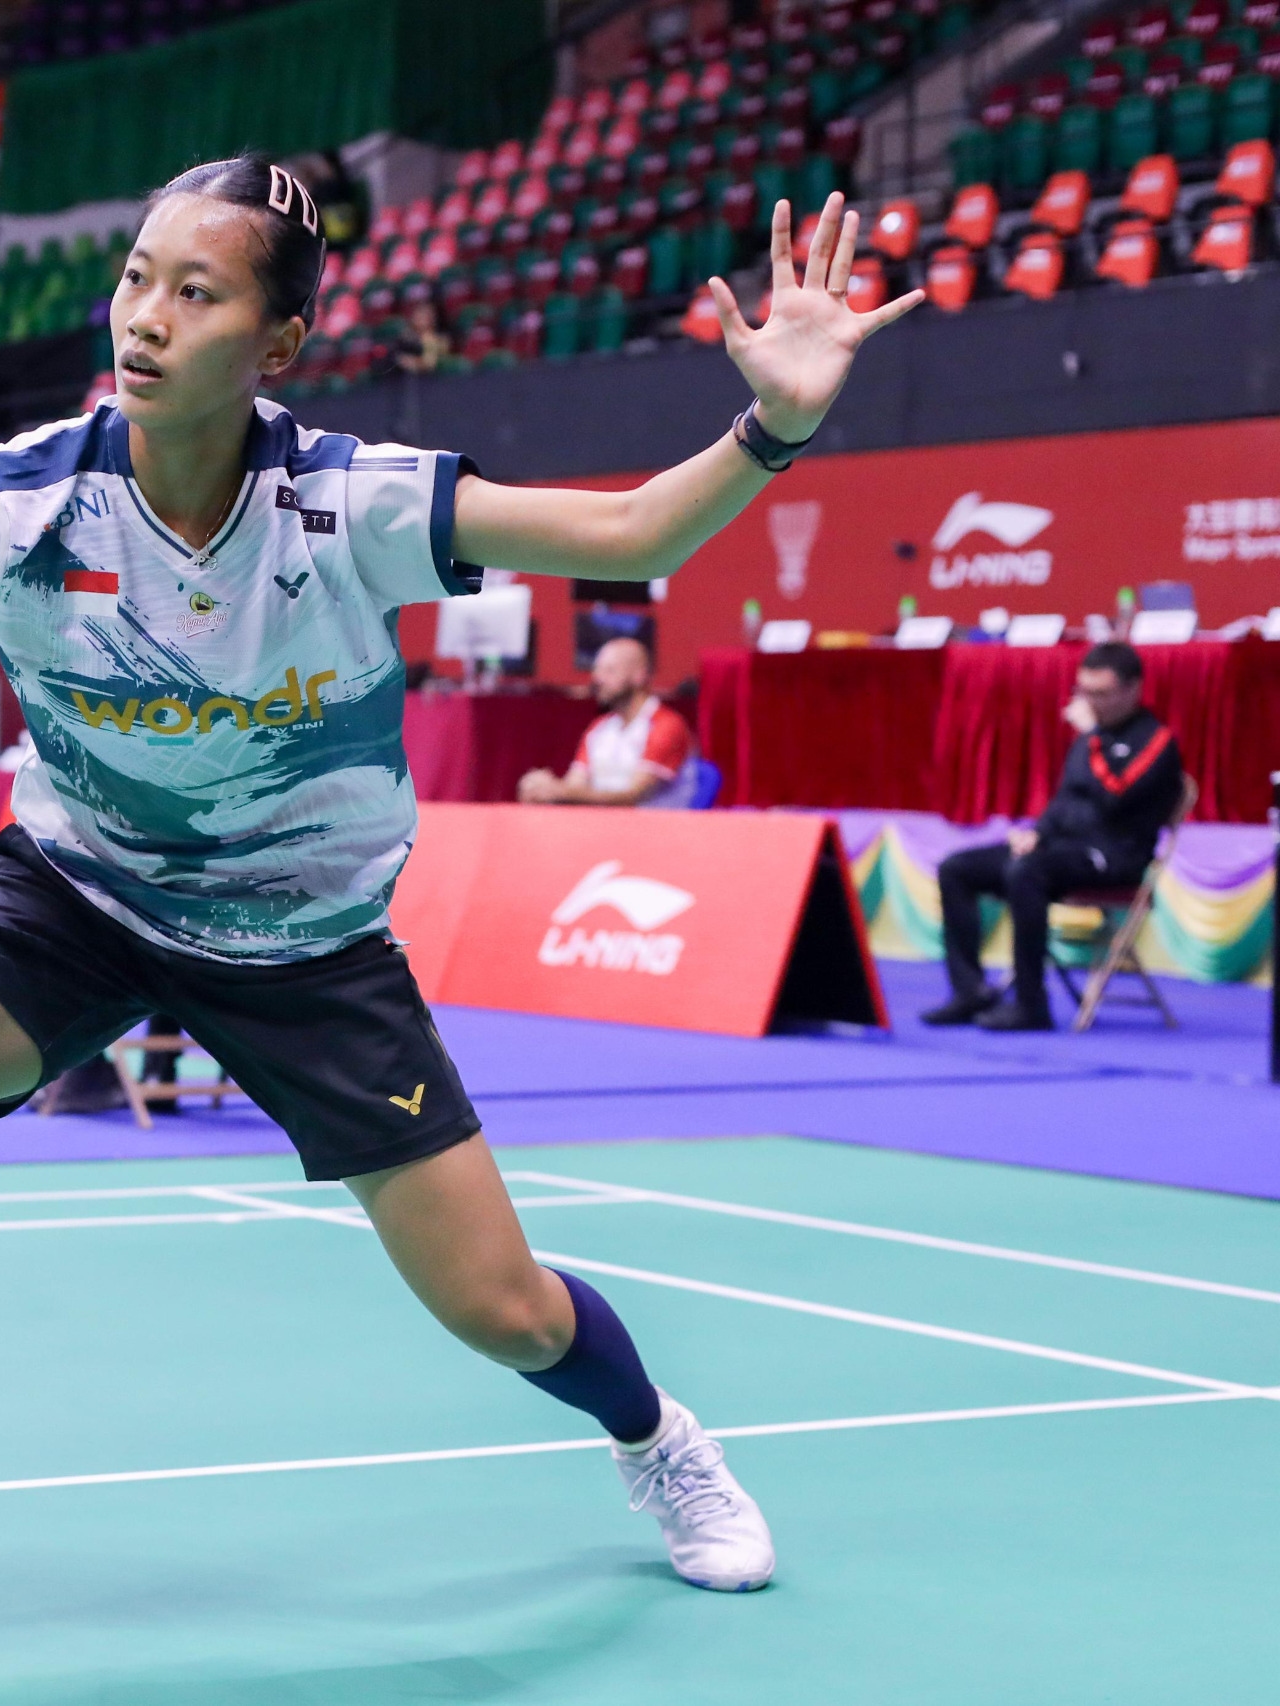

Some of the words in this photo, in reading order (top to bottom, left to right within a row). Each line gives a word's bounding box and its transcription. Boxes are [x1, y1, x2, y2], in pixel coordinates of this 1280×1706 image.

[930, 549, 1053, 589] LI-NING
[71, 666, 337, 735] wondr
[292, 719, 324, 731] BNI
[537, 925, 685, 975] LI-NING
